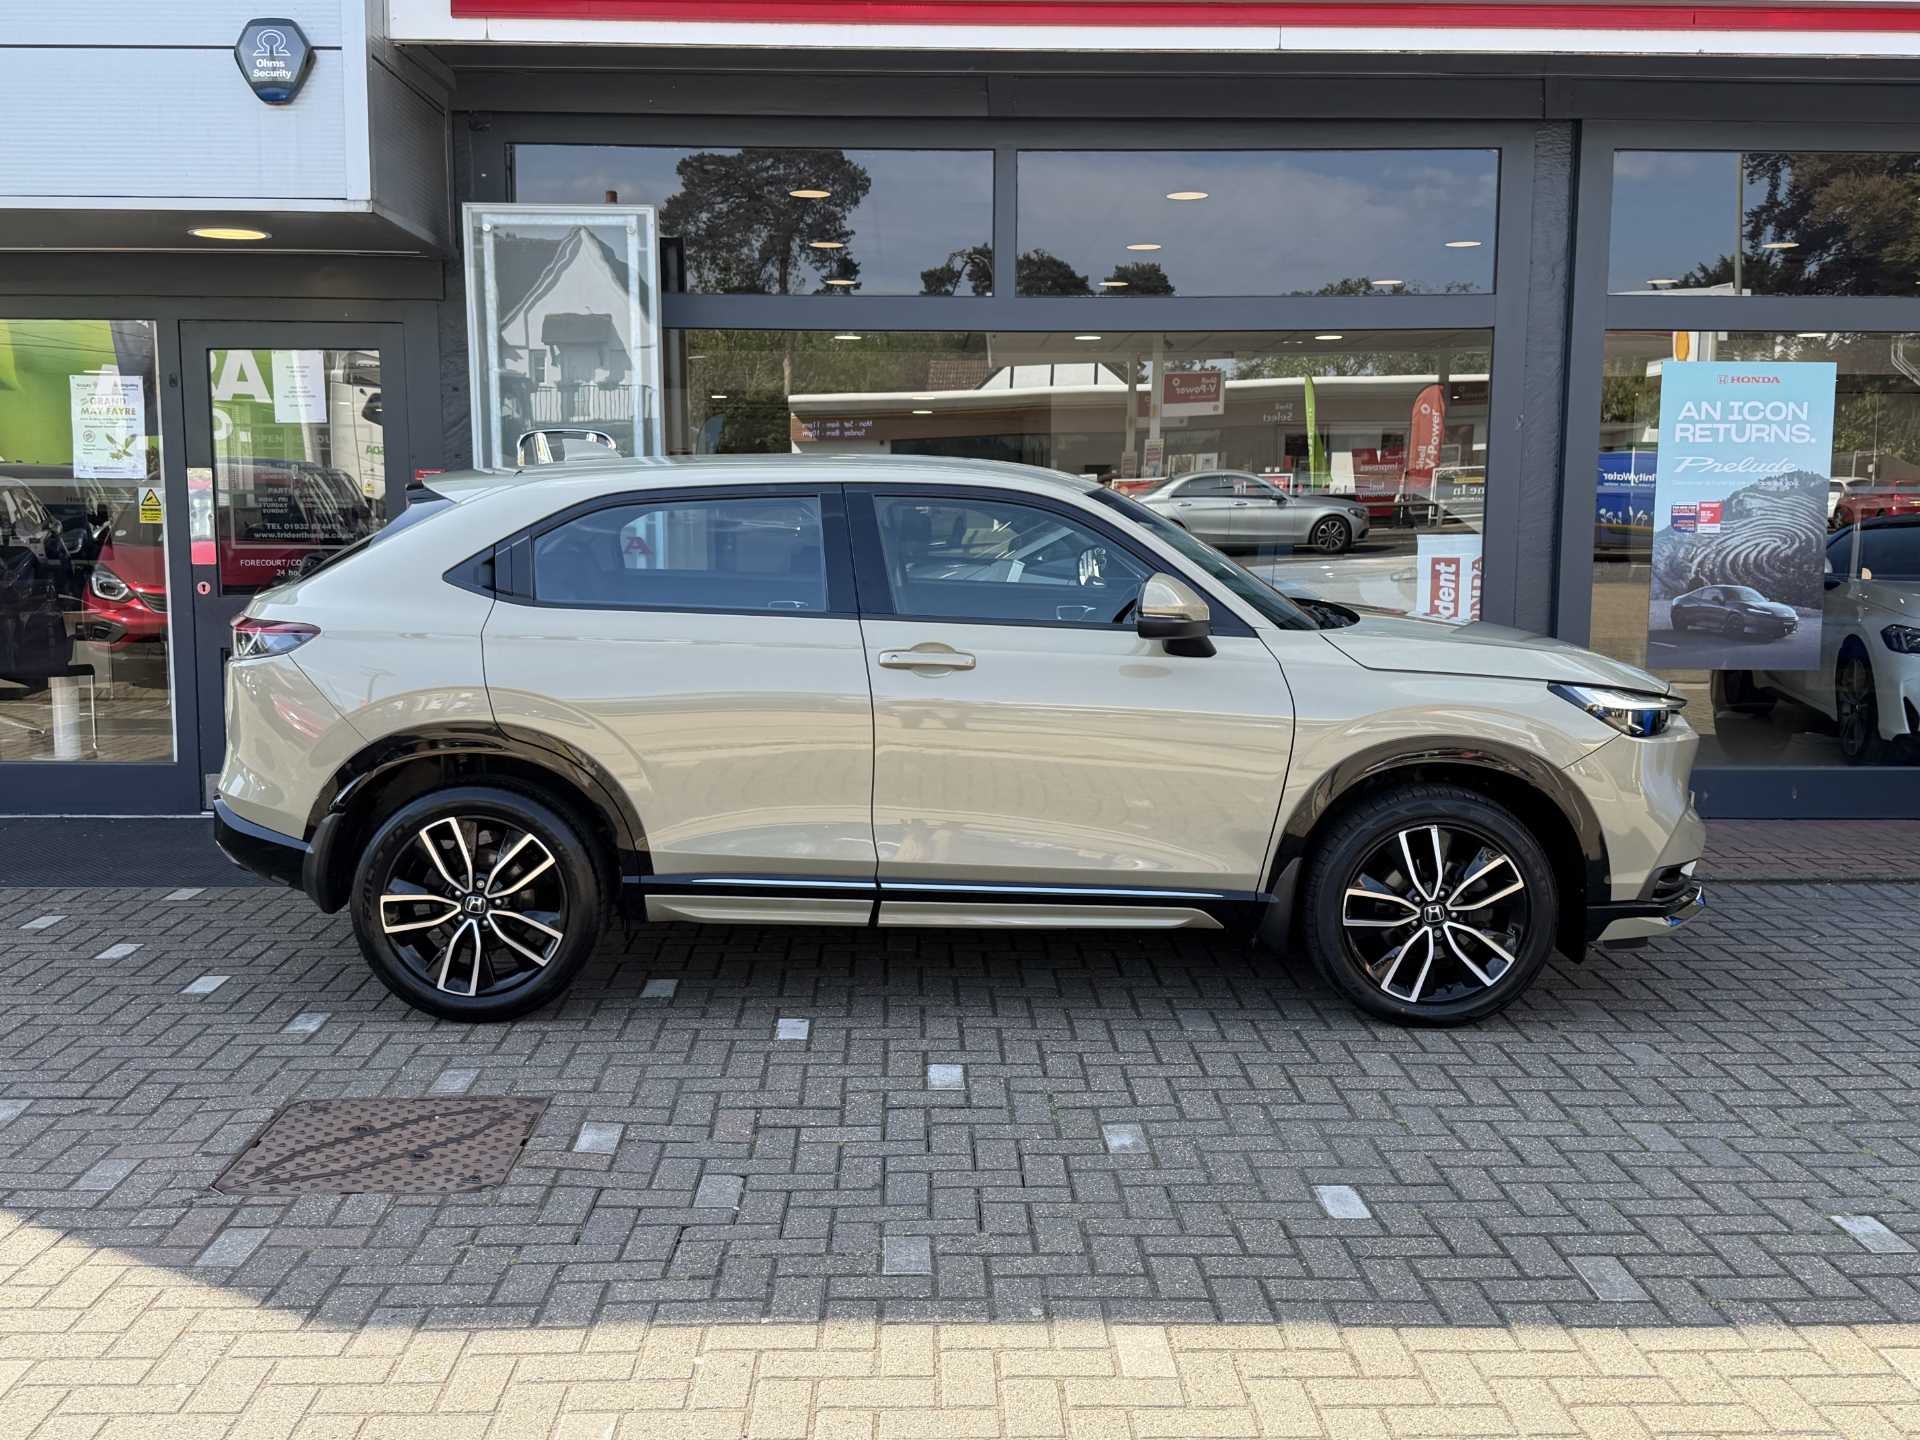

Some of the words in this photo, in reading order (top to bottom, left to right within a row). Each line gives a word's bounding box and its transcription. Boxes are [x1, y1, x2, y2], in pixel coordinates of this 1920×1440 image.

[256, 59, 285, 67] Ohms
[253, 69, 291, 79] Security
[1730, 376, 1780, 384] HONDA
[106, 407, 137, 416] FAYRE
[1678, 401, 1722, 421] AN
[1728, 401, 1809, 421] ICON
[1425, 408, 1440, 470] V-Power
[1675, 423, 1817, 443] RETURNS.
[1416, 446, 1426, 470] Shell
[1674, 456, 1798, 473] Prelude
